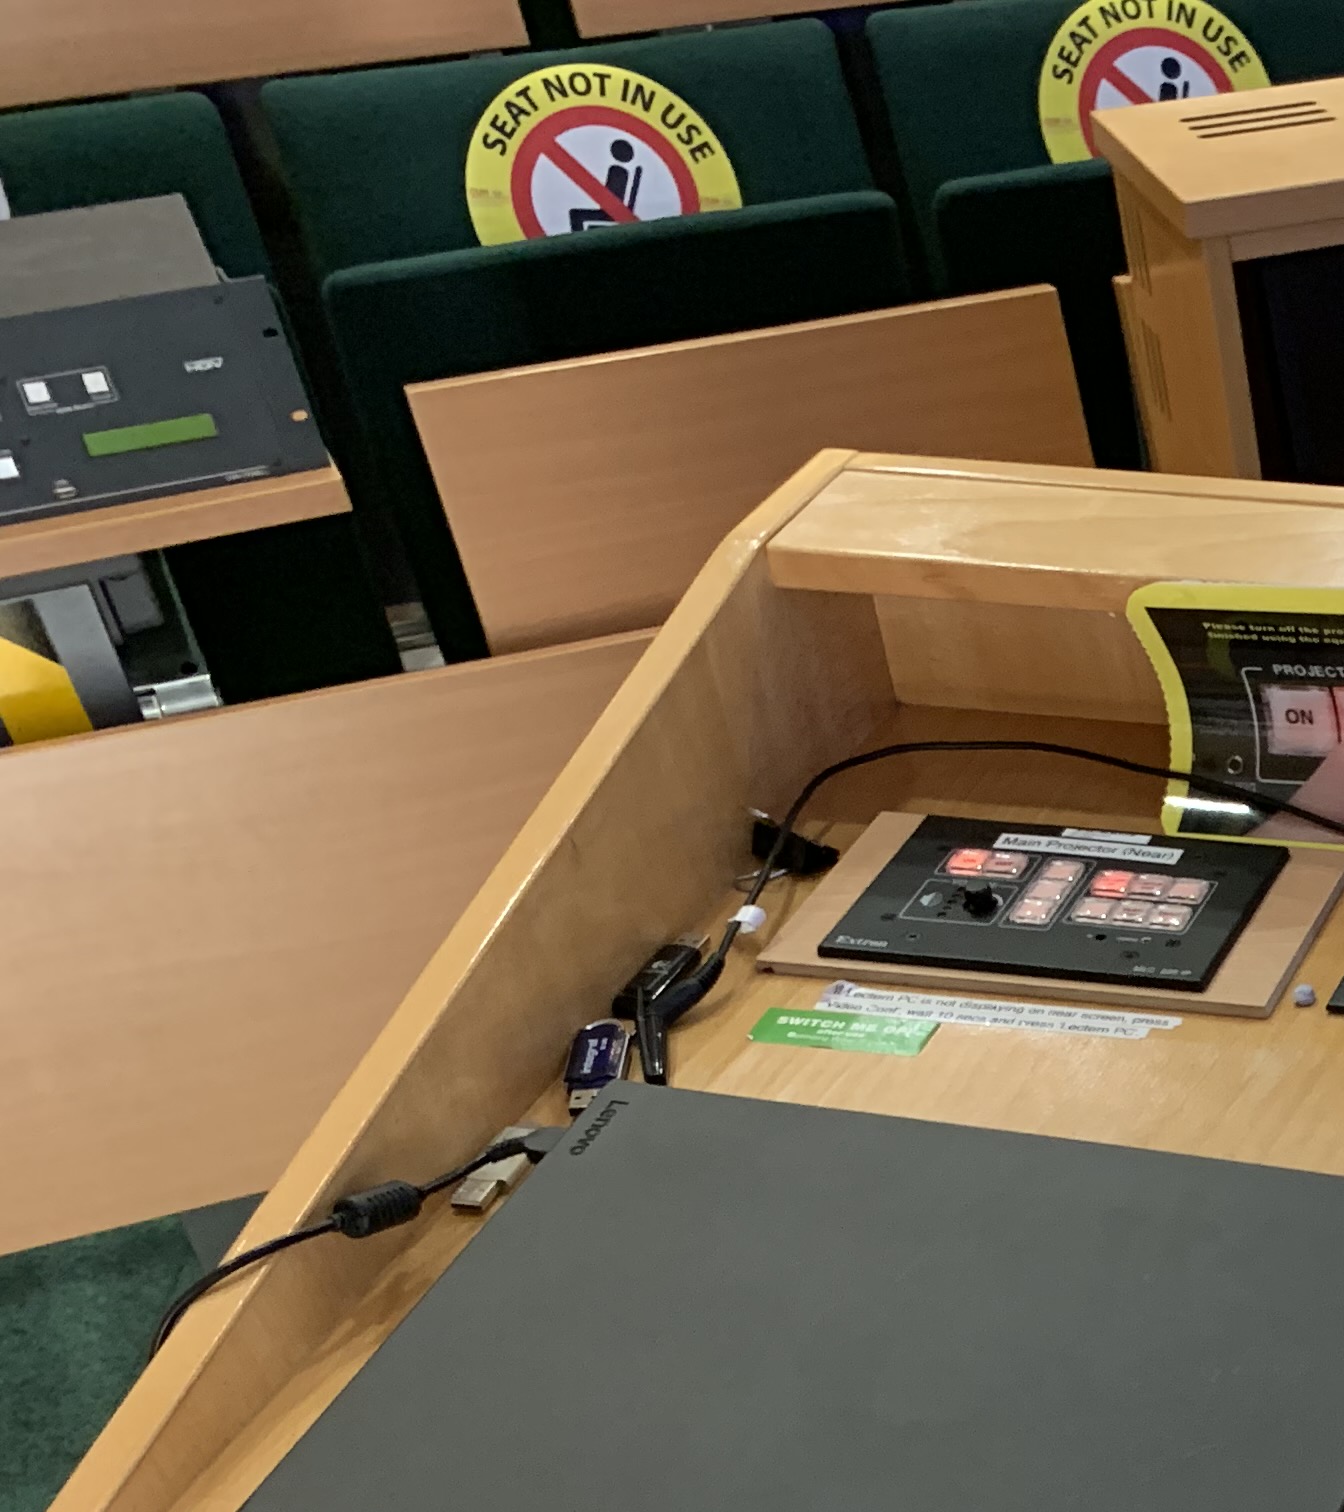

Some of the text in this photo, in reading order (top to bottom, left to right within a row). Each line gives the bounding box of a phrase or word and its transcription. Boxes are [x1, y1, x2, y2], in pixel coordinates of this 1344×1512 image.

[1052, 0, 1251, 84] SEAT NOT IN USE
[482, 72, 716, 164] SEAT NOT IN USE
[1202, 621, 1246, 632] Please
[1249, 623, 1275, 633] turn
[1299, 625, 1319, 635] the
[1299, 635, 1320, 644] the
[1284, 708, 1314, 725] ON
[1002, 836, 1176, 861] Main Projector (Near)
[898, 994, 917, 1004] PC
[936, 998, 956, 1008] not
[777, 1015, 847, 1030] SWITCH
[850, 1022, 879, 1032] ME
[569, 1100, 630, 1156] Lenovo
